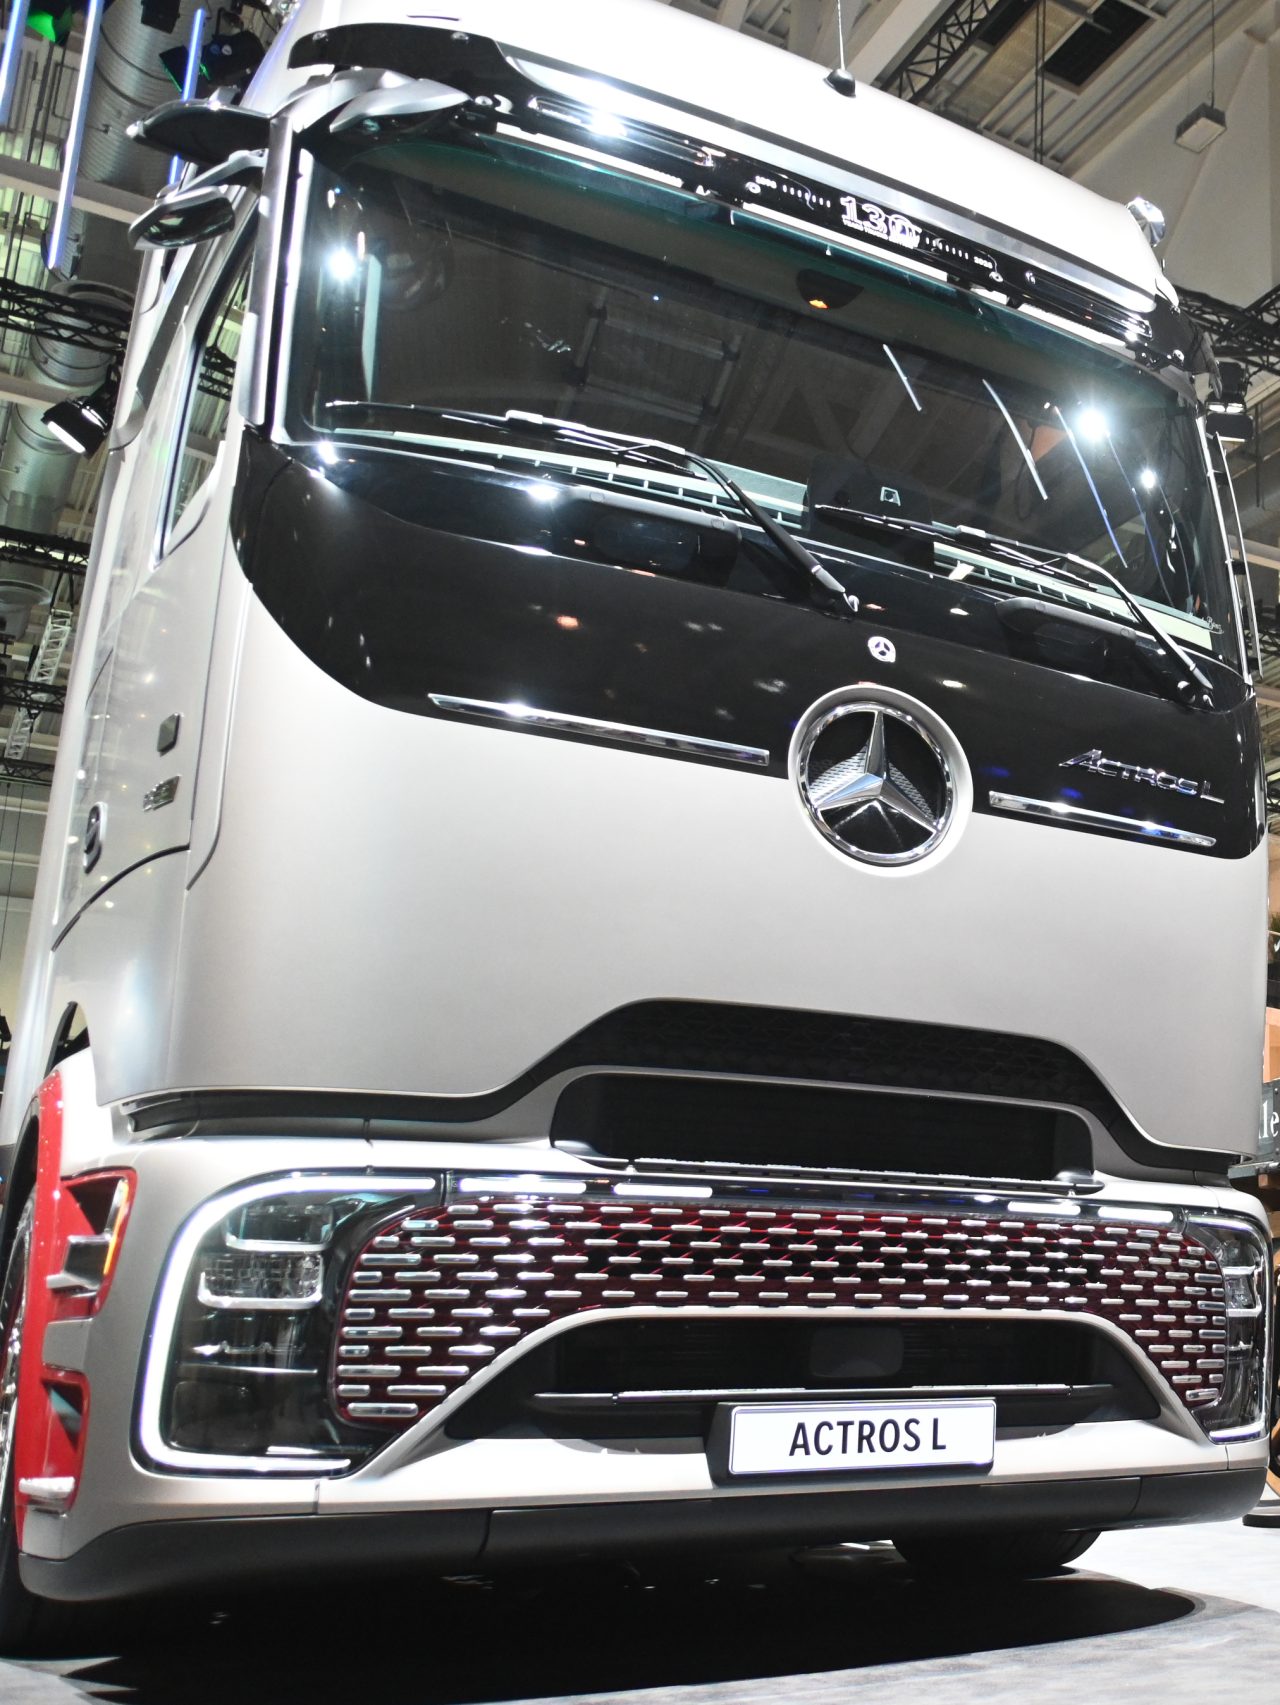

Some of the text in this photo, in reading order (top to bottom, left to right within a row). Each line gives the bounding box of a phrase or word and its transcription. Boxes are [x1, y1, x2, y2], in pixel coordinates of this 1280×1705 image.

[840, 196, 917, 241] 130
[1200, 780, 1225, 804] L
[788, 1417, 947, 1457] ACTROS L
